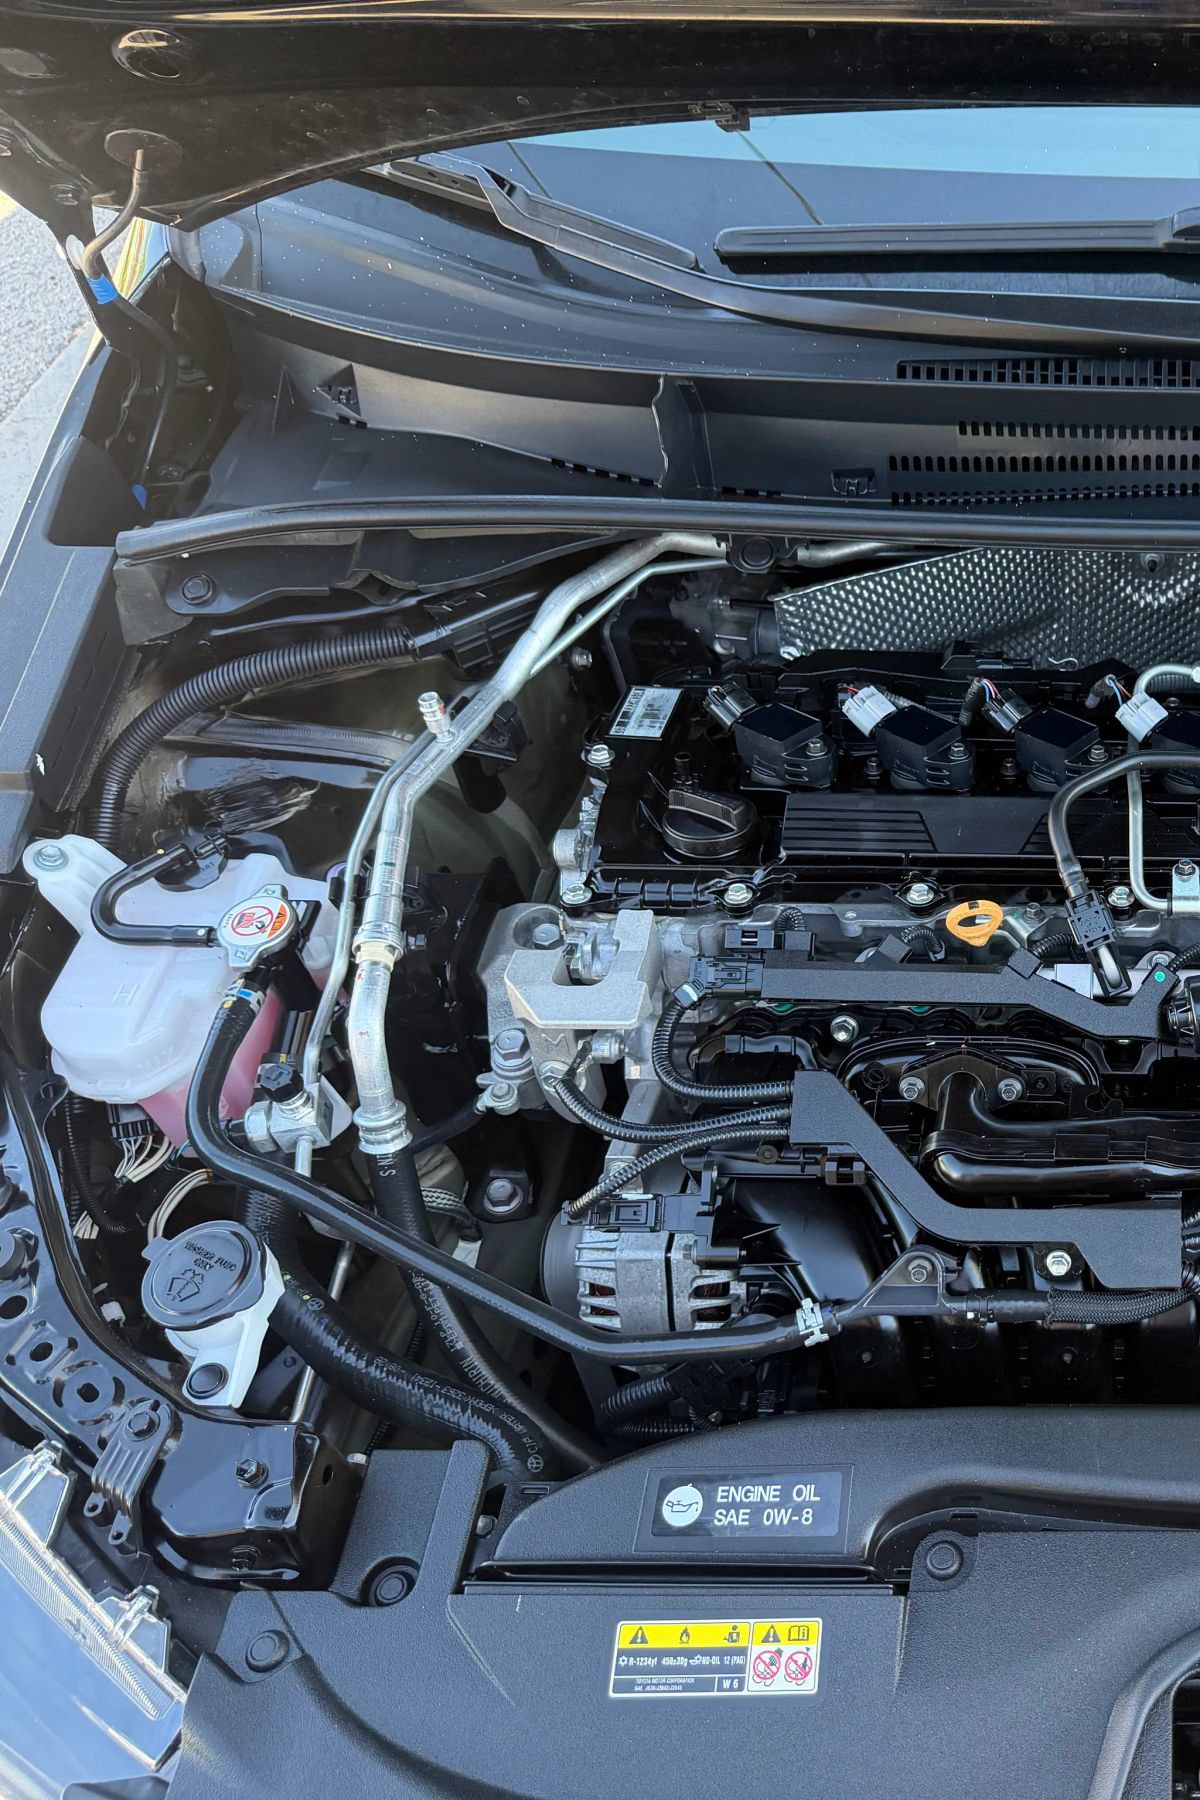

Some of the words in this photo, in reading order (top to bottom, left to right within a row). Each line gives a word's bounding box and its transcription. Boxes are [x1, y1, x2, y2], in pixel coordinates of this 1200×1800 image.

[716, 1485, 782, 1503] ENGINE
[792, 1484, 821, 1501] OIL
[713, 1509, 750, 1525] SAE
[763, 1508, 813, 1525] 0W-8
[730, 1654, 746, 1666] (PAG)
[722, 1679, 732, 1689] W
